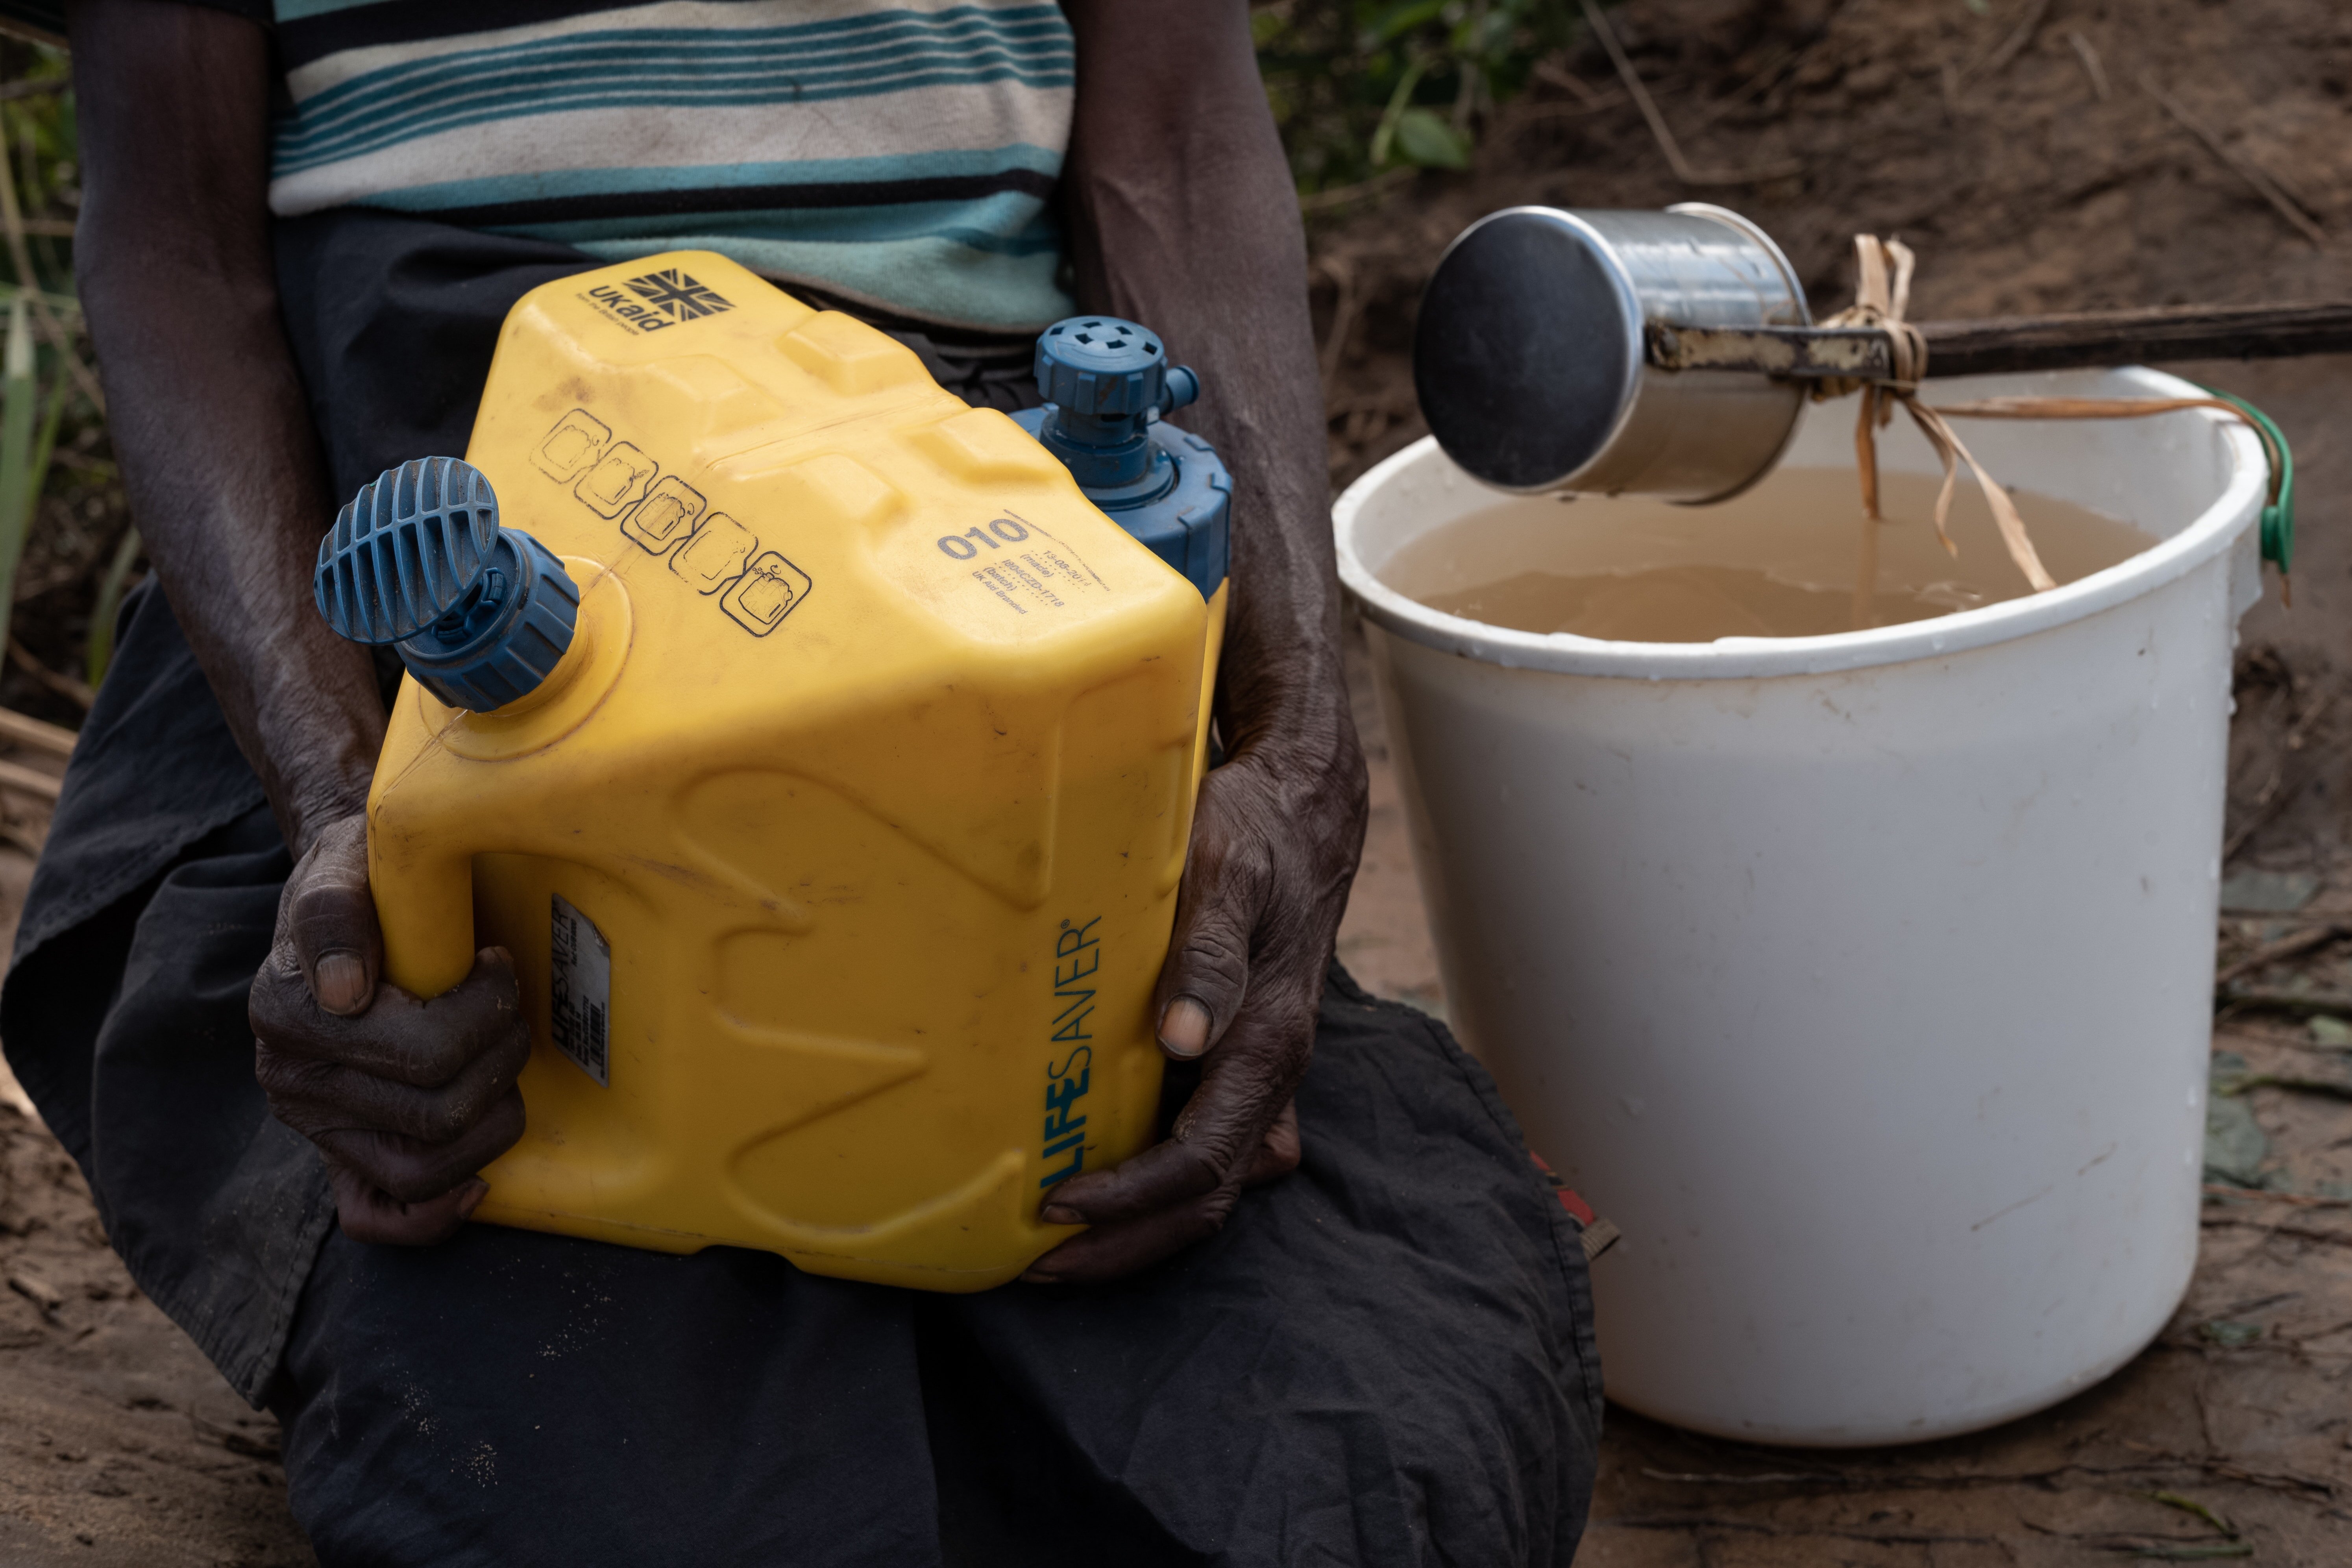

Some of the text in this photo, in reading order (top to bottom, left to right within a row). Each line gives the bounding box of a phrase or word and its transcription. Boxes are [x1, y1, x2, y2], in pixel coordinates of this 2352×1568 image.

[937, 518, 1029, 560] 010
[982, 567, 1018, 591] (batch)
[1020, 554, 1055, 578] (made)
[972, 571, 1028, 614] UK Aid Branded
